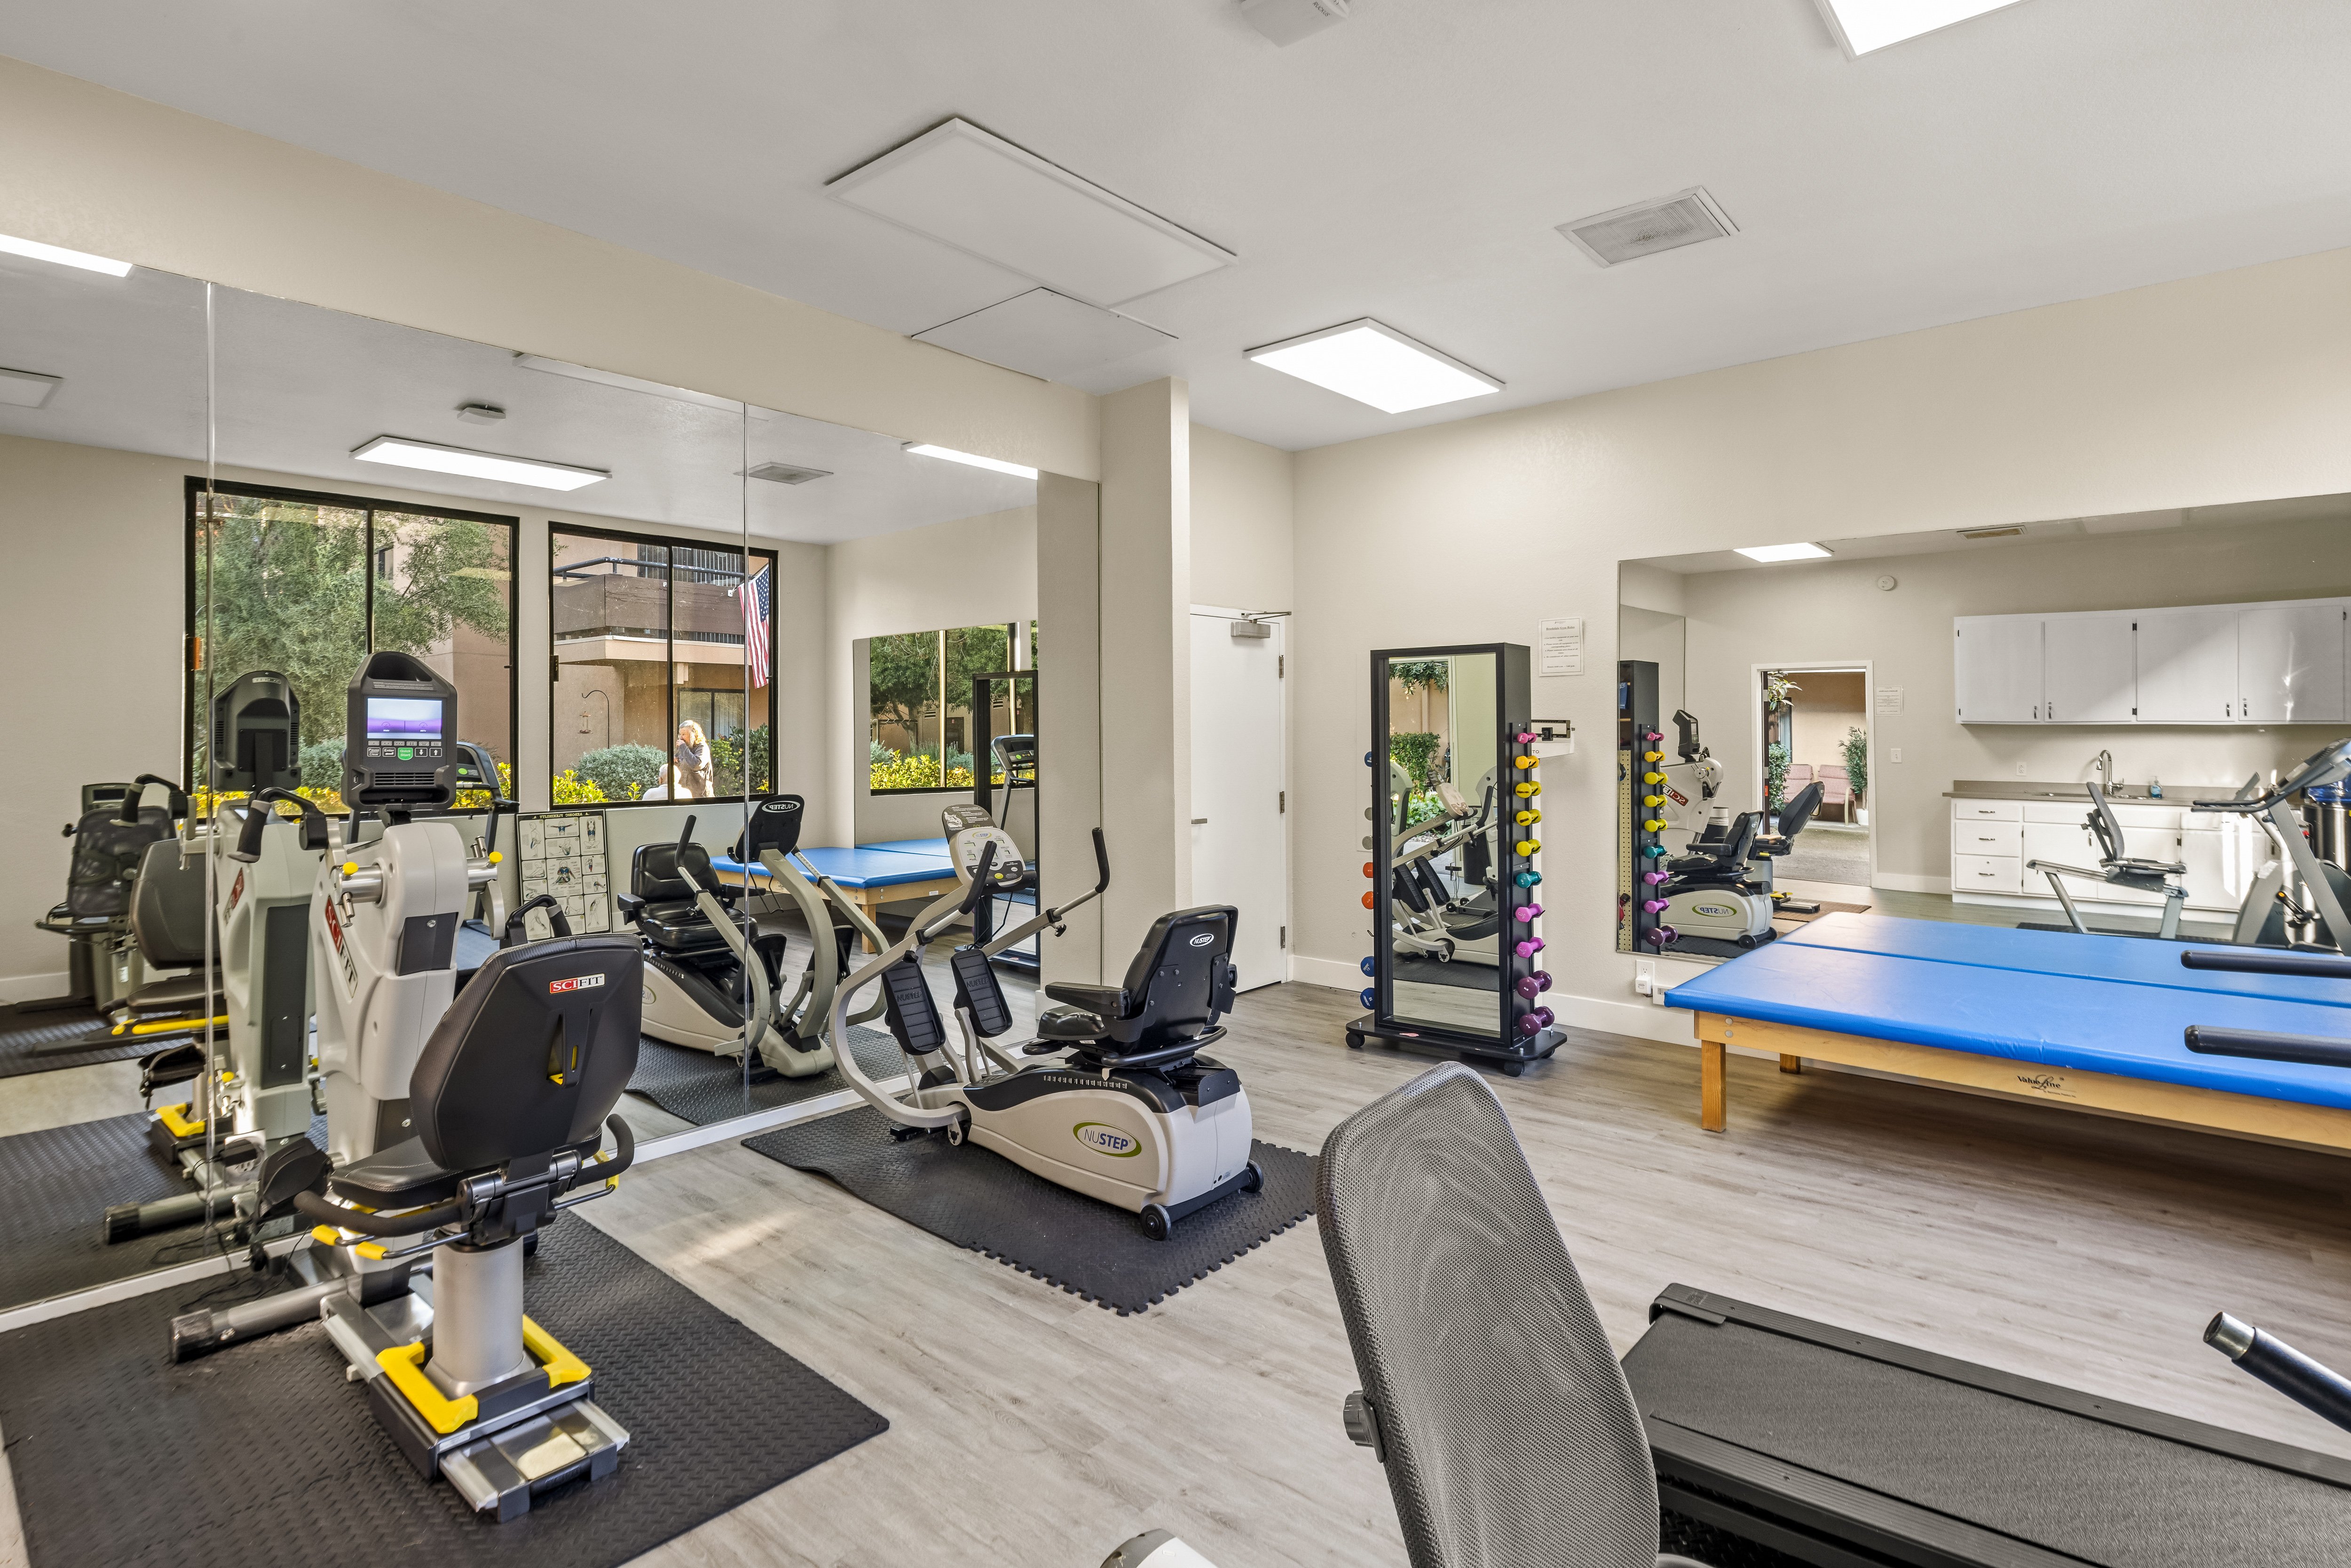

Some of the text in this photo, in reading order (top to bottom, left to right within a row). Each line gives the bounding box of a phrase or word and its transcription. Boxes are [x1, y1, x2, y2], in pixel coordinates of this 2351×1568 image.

[1194, 936, 1210, 945] NUSTEP
[553, 976, 603, 991] SCIFIT
[967, 978, 988, 987] NUSTEP
[1084, 1128, 1128, 1150] NUSTEP
